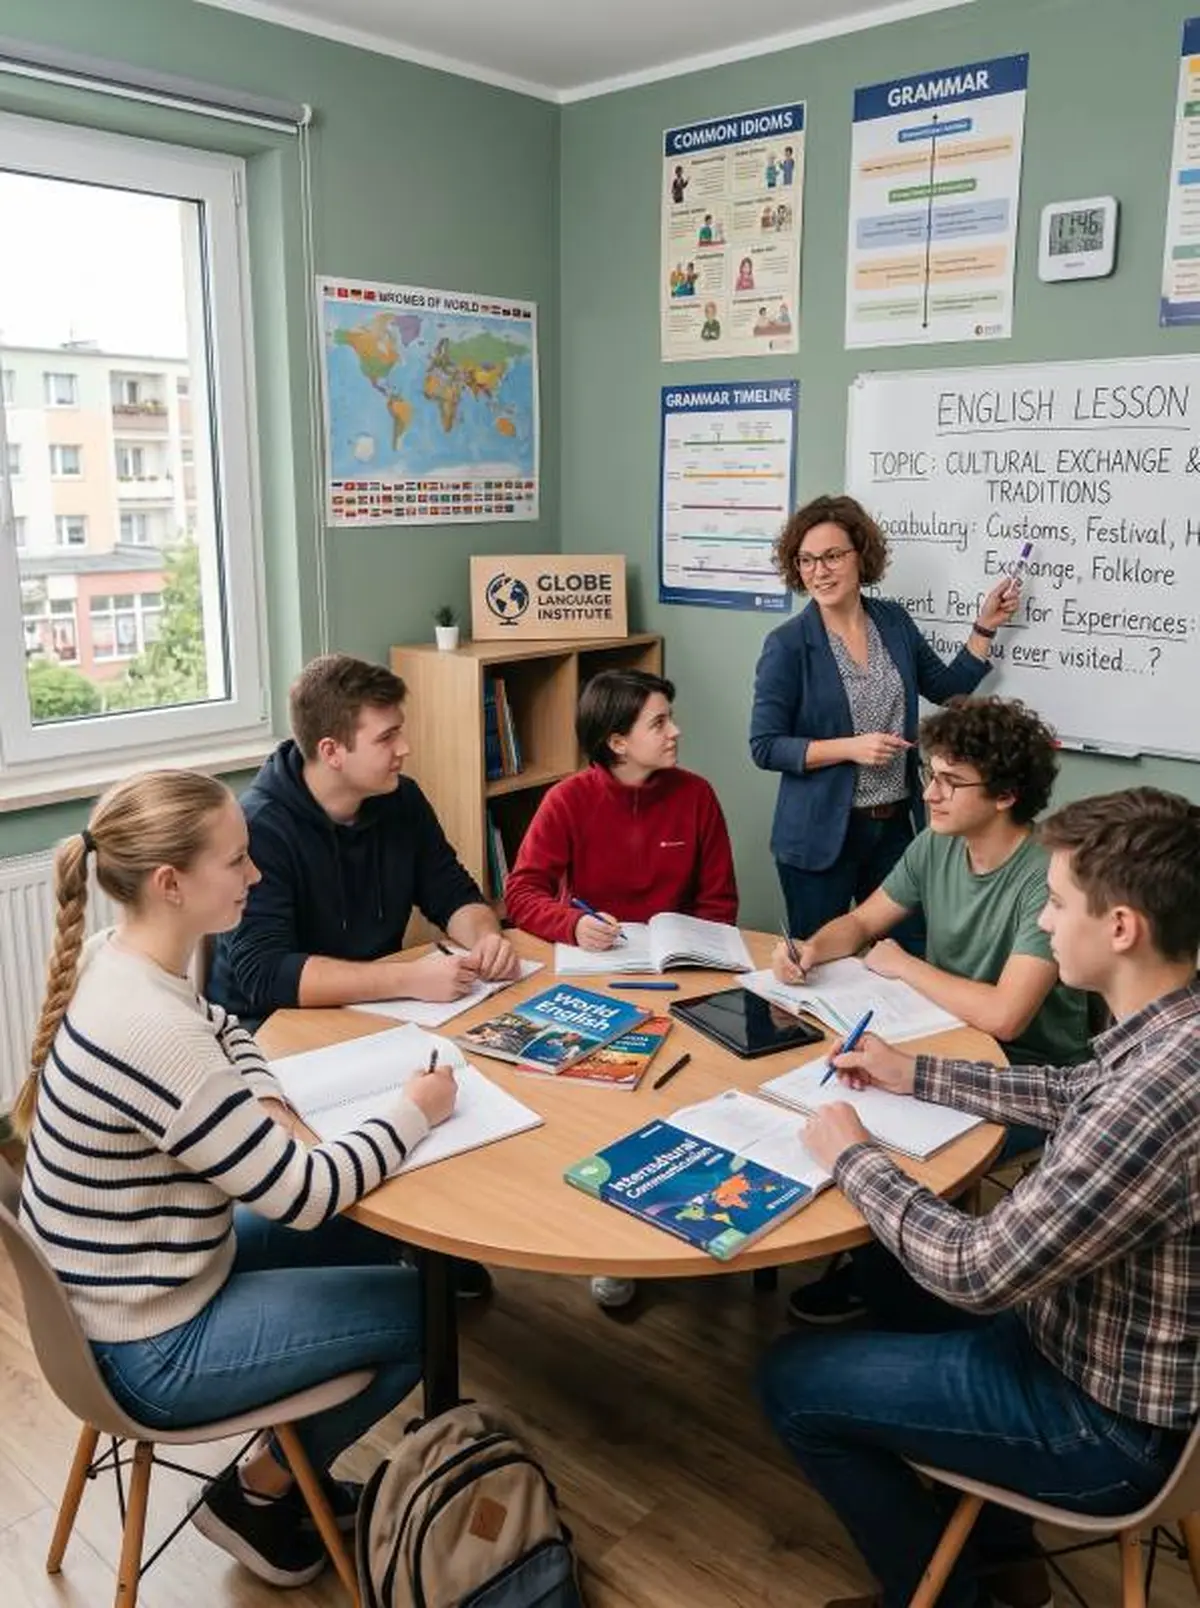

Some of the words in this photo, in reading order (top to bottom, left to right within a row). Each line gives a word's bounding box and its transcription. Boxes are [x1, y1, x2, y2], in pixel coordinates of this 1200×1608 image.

[887, 70, 990, 108] GRAMMAR
[673, 121, 738, 151] COMMON
[740, 111, 793, 136] IDIOMS
[665, 391, 730, 408] GRAMMAR
[733, 388, 793, 404] TIMELINE
[937, 389, 1055, 426] ENGLISH
[1073, 385, 1190, 421] LESSON
[869, 450, 936, 476] TOPIC:
[945, 449, 1047, 476] CULTURAL
[1056, 446, 1173, 475] EXCHANGE
[1185, 446, 1200, 474] &
[986, 480, 1113, 505] TRADITIONS
[985, 512, 1078, 546] Customs,
[1086, 516, 1176, 550] Festival,
[538, 574, 612, 592] GLOBE
[1091, 556, 1176, 587] Folklore
[538, 594, 612, 606] LANGUAGE
[538, 608, 613, 621] INSTITUTE
[869, 585, 935, 614] Psent
[1025, 596, 1053, 622] for
[1062, 598, 1196, 636] Experiences:
[1012, 648, 1051, 664] ever
[534, 1000, 611, 1031] English
[554, 992, 621, 1019] World
